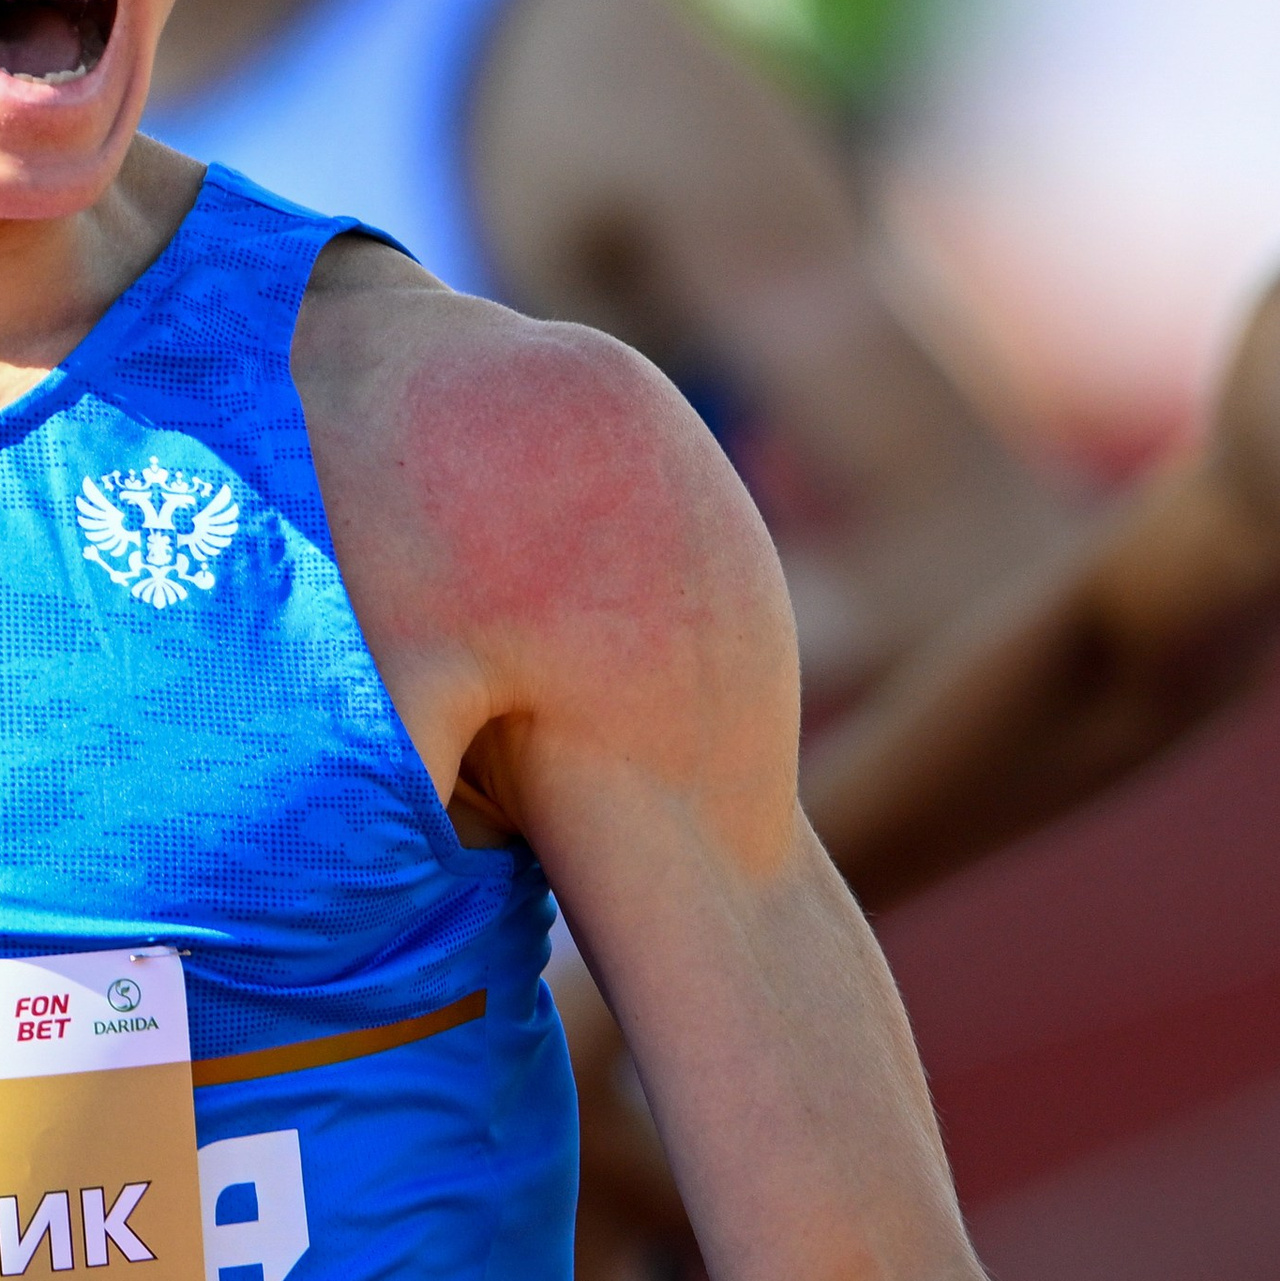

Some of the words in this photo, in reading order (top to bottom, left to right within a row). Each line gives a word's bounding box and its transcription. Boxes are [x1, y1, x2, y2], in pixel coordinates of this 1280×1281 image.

[15, 994, 70, 1018] FON
[17, 1018, 72, 1042] BET
[94, 1016, 160, 1036] DARIDA
